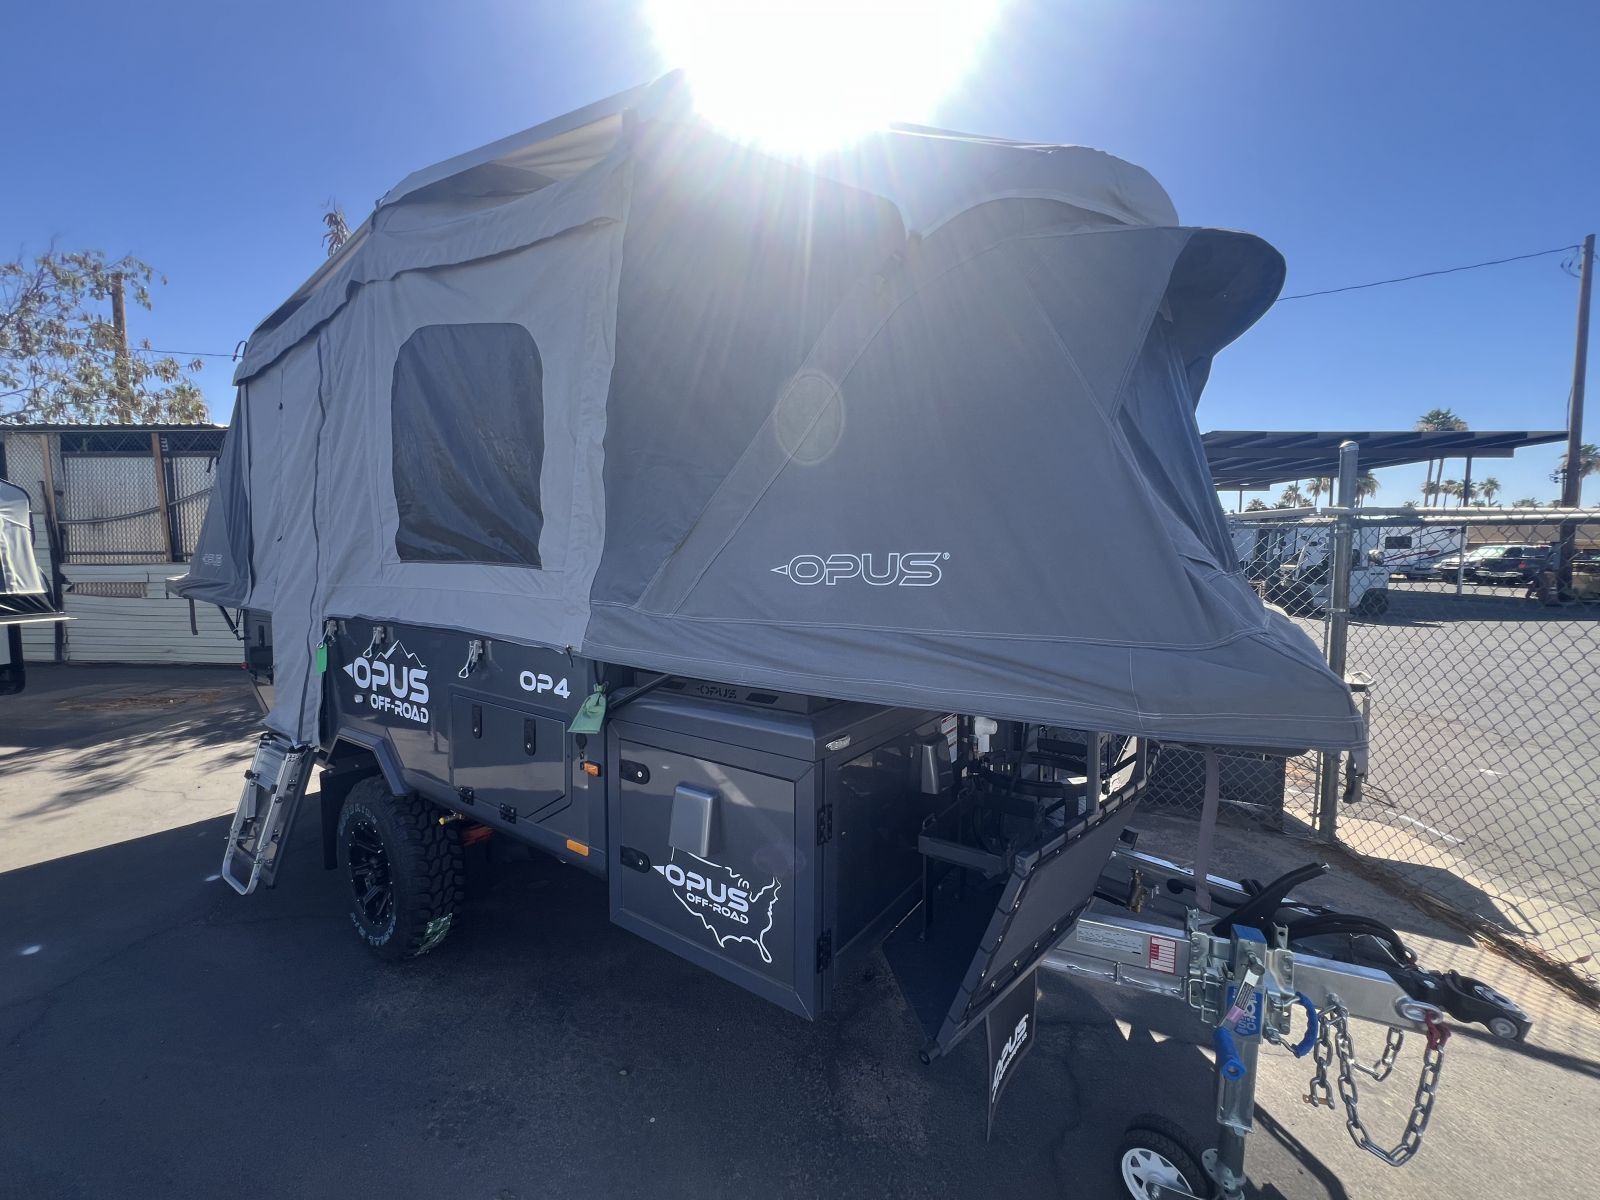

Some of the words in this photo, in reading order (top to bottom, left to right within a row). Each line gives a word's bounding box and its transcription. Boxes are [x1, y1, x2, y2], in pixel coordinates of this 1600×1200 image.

[353, 656, 429, 704] OPUS
[519, 670, 571, 699] OP4
[700, 684, 737, 699] OPUS
[370, 693, 429, 724] OFF-ROAD
[665, 864, 749, 913] OPUS
[686, 892, 749, 924] OFF-ROAD
